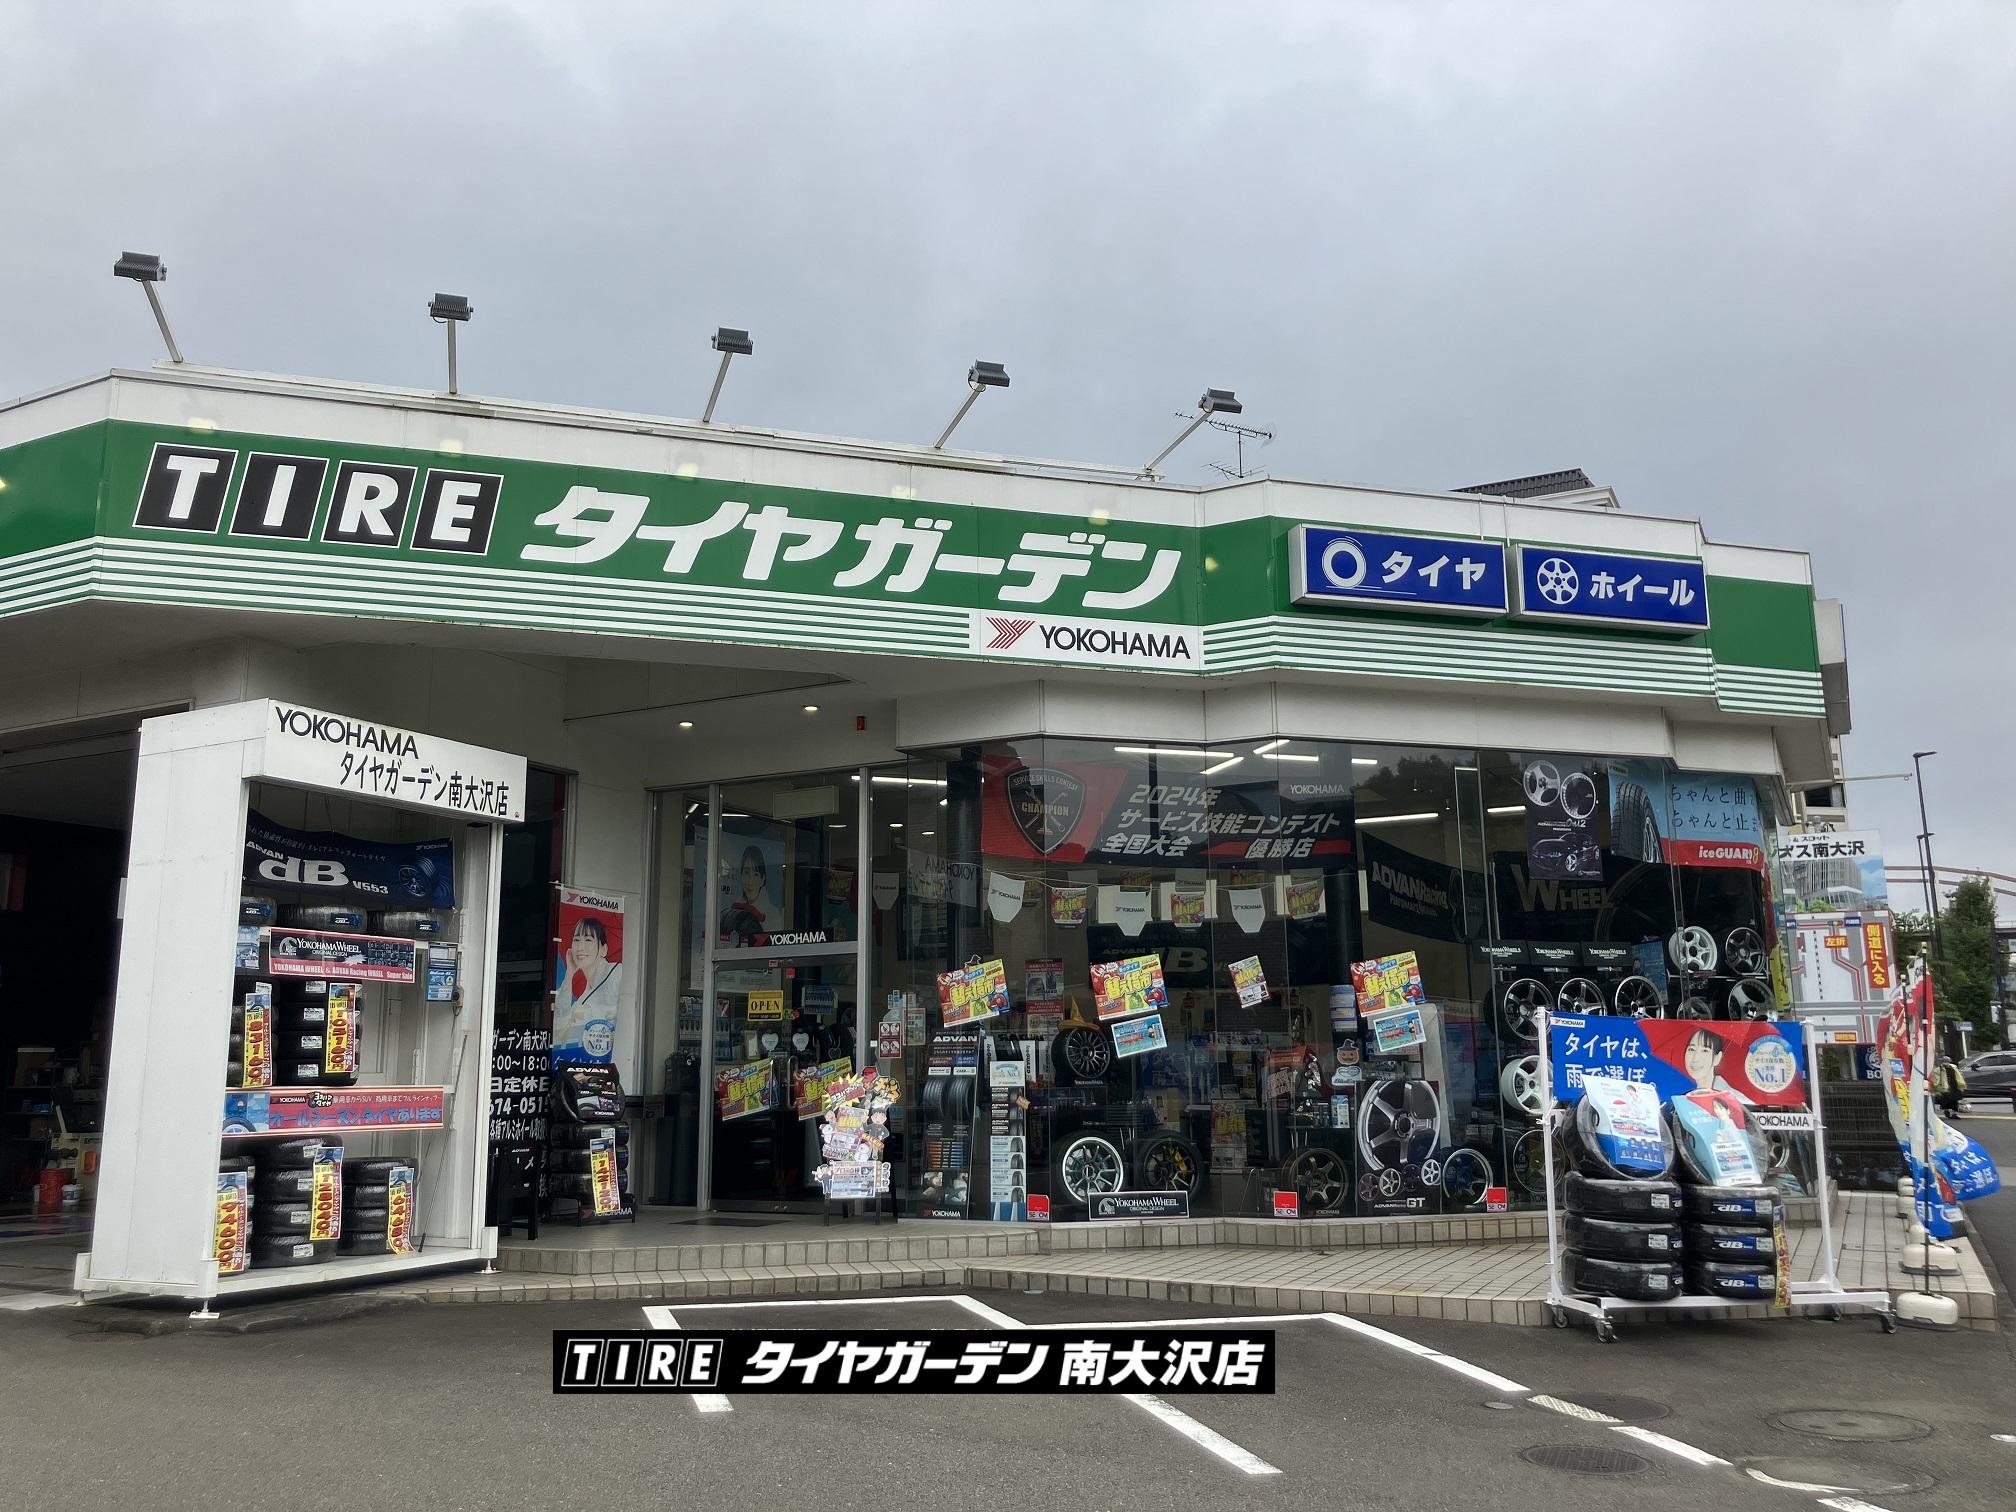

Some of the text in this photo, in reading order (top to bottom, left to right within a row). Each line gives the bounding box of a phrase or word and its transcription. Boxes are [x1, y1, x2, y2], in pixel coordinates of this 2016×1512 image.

[166, 454, 484, 544] TIRE
[520, 485, 1182, 610] タイヤガーデン
[1381, 550, 1486, 590] タイヤ
[1589, 571, 1695, 607] ホイール
[1039, 624, 1191, 660] YOKOHAMA
[275, 706, 419, 759] YOKOHAMA
[340, 750, 509, 817] タイヤガーデン南大沢店
[1289, 784, 1344, 795] YOKOHAMA
[1128, 784, 1222, 807] 2024年
[1021, 802, 1069, 816] CHAMPION
[1117, 809, 1341, 835] サービス技能コンテスト
[1101, 832, 1314, 859] 全国大会 優勝店
[259, 856, 389, 894] dB V553
[579, 896, 619, 910] YOKOHAMA
[997, 891, 1021, 901] YOKOHAMA
[297, 938, 337, 951] YOKOHAMA
[770, 931, 826, 946] YOKOHAMA
[1826, 937, 1845, 946] 左折
[1866, 924, 1886, 986] 側道に入る
[274, 962, 304, 972] YOKOHAMA
[305, 964, 323, 973] WHEEL
[367, 967, 383, 978] WHEEL
[1754, 1069, 1788, 1085] No.1
[270, 1106, 443, 1127] オールシーズンタイヤあります
[1114, 1197, 1180, 1207] YOKOHAMA WHEEL
[1406, 1198, 1426, 1208] GT
[931, 1210, 961, 1218] YOKOHAMA
